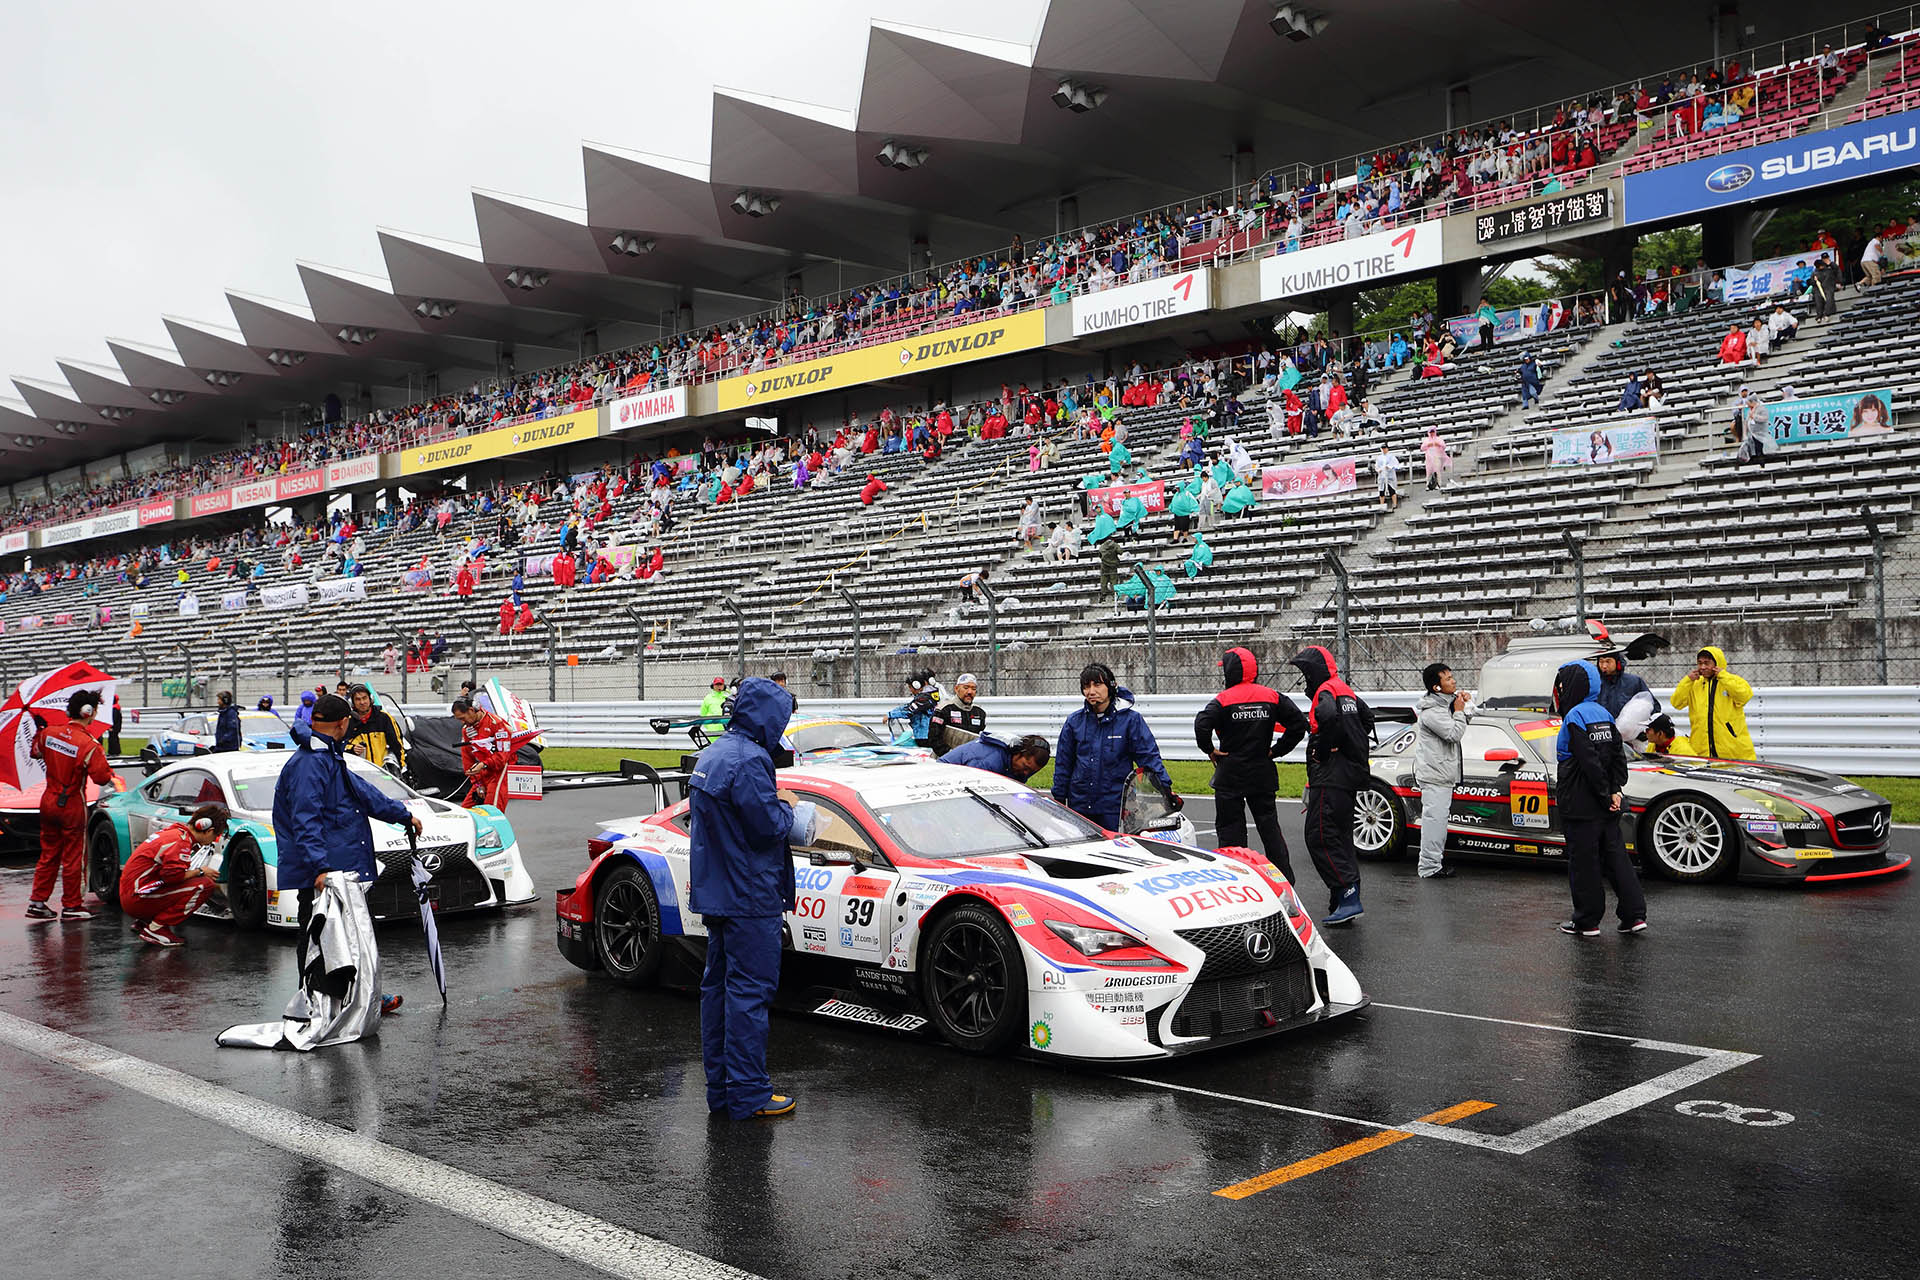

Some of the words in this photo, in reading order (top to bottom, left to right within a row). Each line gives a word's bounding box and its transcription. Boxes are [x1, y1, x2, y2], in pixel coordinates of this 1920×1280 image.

[1761, 128, 1916, 180] SUBARU
[1511, 211, 1527, 223] 1st
[1528, 204, 1545, 219] 2nd
[1547, 200, 1564, 214] 3rd
[1566, 197, 1584, 209] 4th
[1586, 192, 1604, 206] 5th
[1478, 228, 1495, 241] LAP
[1499, 224, 1509, 236] 17
[1531, 216, 1543, 229] 23
[1551, 212, 1561, 226] 17
[1568, 207, 1584, 221] 100
[1589, 203, 1601, 217] 39
[1478, 217, 1494, 229] 500
[1281, 263, 1350, 295] KUMHO
[1353, 254, 1395, 281] TIRE
[1084, 304, 1140, 332] KUMHO
[1143, 296, 1177, 322] TIRE
[915, 329, 1005, 361] DUNLOP
[759, 366, 833, 394] DUNLOP
[632, 394, 675, 420] YAMAHA
[522, 422, 575, 443] DUNLOP
[427, 444, 472, 463] DUNLOP
[341, 460, 376, 480] DAIHATSU
[236, 485, 271, 503] NISSAN
[280, 475, 319, 494] NISSAN
[149, 505, 172, 517] HINO
[195, 494, 228, 513] NISSAN
[1231, 709, 1270, 720] OFFICIAL
[50, 741, 76, 756] PETRONAS
[1518, 795, 1540, 813] 10
[1466, 840, 1510, 850] DUNLOP
[927, 883, 949, 892] JTEKT
[1134, 869, 1238, 896] KOBELCO
[1168, 886, 1263, 919] DENSO
[845, 898, 875, 927] 39
[803, 929, 827, 941] TRD
[808, 943, 826, 953] Castrol
[897, 960, 908, 968] LG
[882, 974, 898, 983] END
[1104, 974, 1178, 988] BRIDGESTONE
[818, 1000, 924, 1030] BRIDGESTONE
[1043, 1011, 1054, 1021] bp
[1102, 1005, 1144, 1013] トヨタ紡織
[1120, 1016, 1144, 1025] BBS
